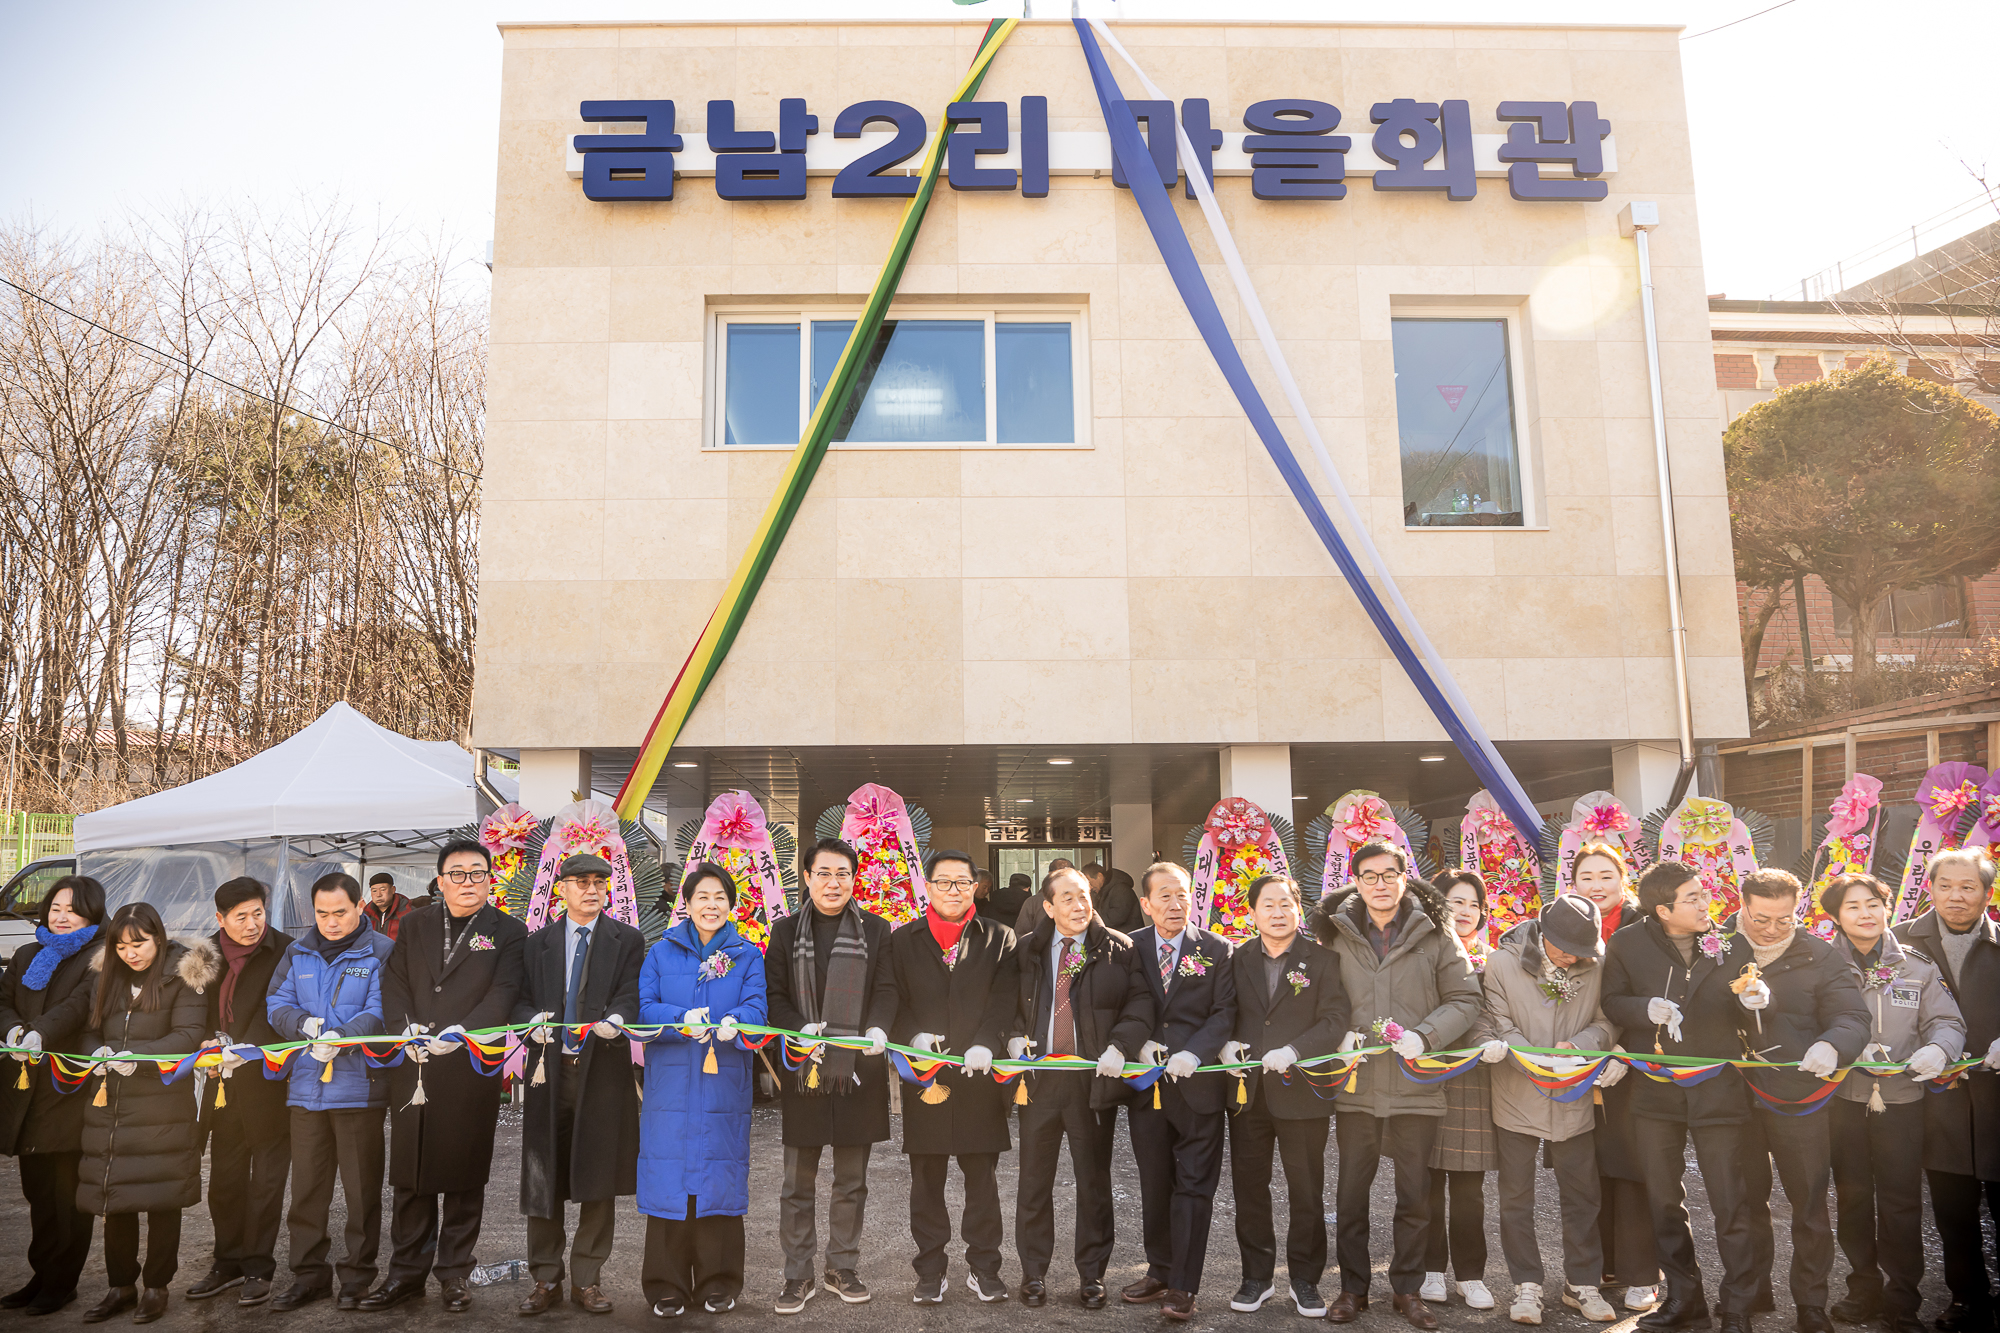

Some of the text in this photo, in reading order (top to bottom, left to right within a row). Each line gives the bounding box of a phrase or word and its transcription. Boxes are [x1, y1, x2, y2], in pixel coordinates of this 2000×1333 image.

[574, 96, 1612, 202] 금남2리 마을회관
[989, 826, 1112, 840] 금남2리 마을회관
[1893, 999, 1918, 1008] POLICE
